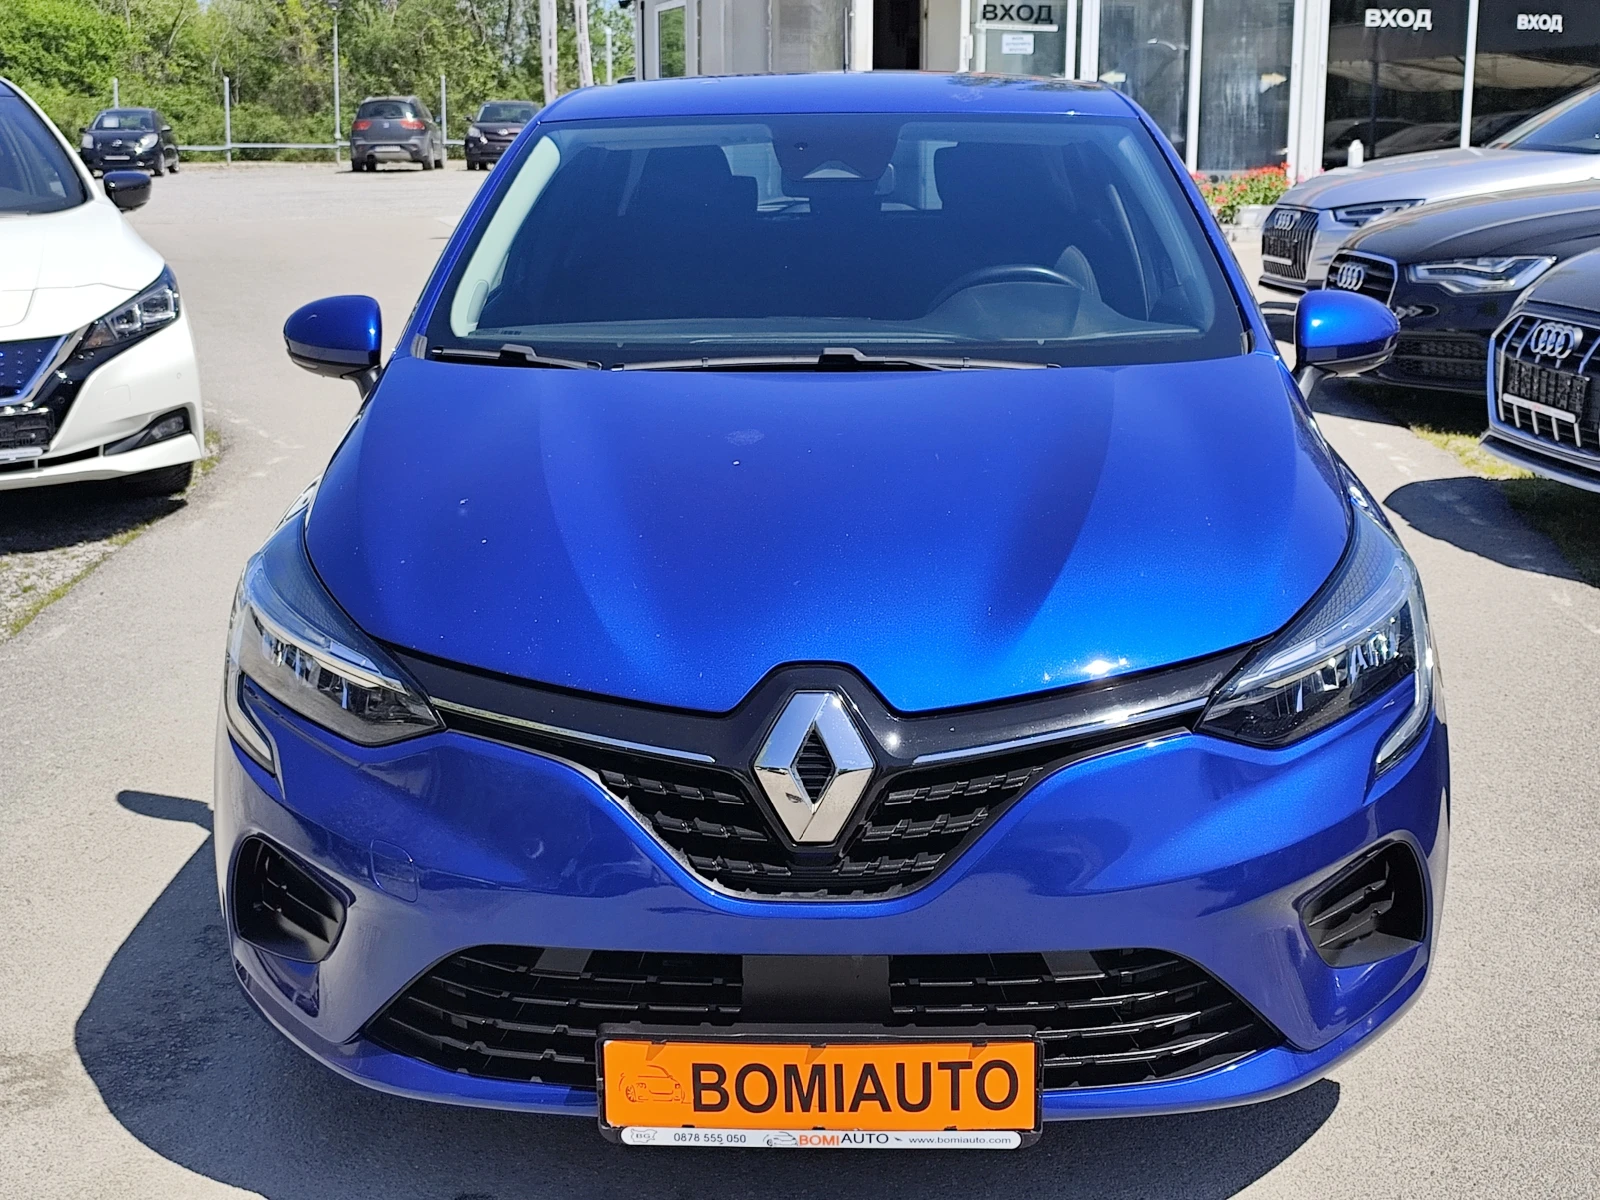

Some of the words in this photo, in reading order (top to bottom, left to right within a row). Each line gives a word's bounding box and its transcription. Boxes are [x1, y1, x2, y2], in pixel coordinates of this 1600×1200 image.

[982, 4, 1053, 24] ВХОД
[1364, 8, 1432, 31] ВХОД
[1517, 14, 1563, 33] ВХОД
[692, 1060, 1019, 1113] BOMIAUTO
[673, 1133, 700, 1143] 0878
[703, 1133, 723, 1143] 555
[726, 1133, 747, 1143] 050
[799, 1133, 889, 1146] BOMIAUTO
[909, 1136, 1011, 1145] www.bomiauto.com
